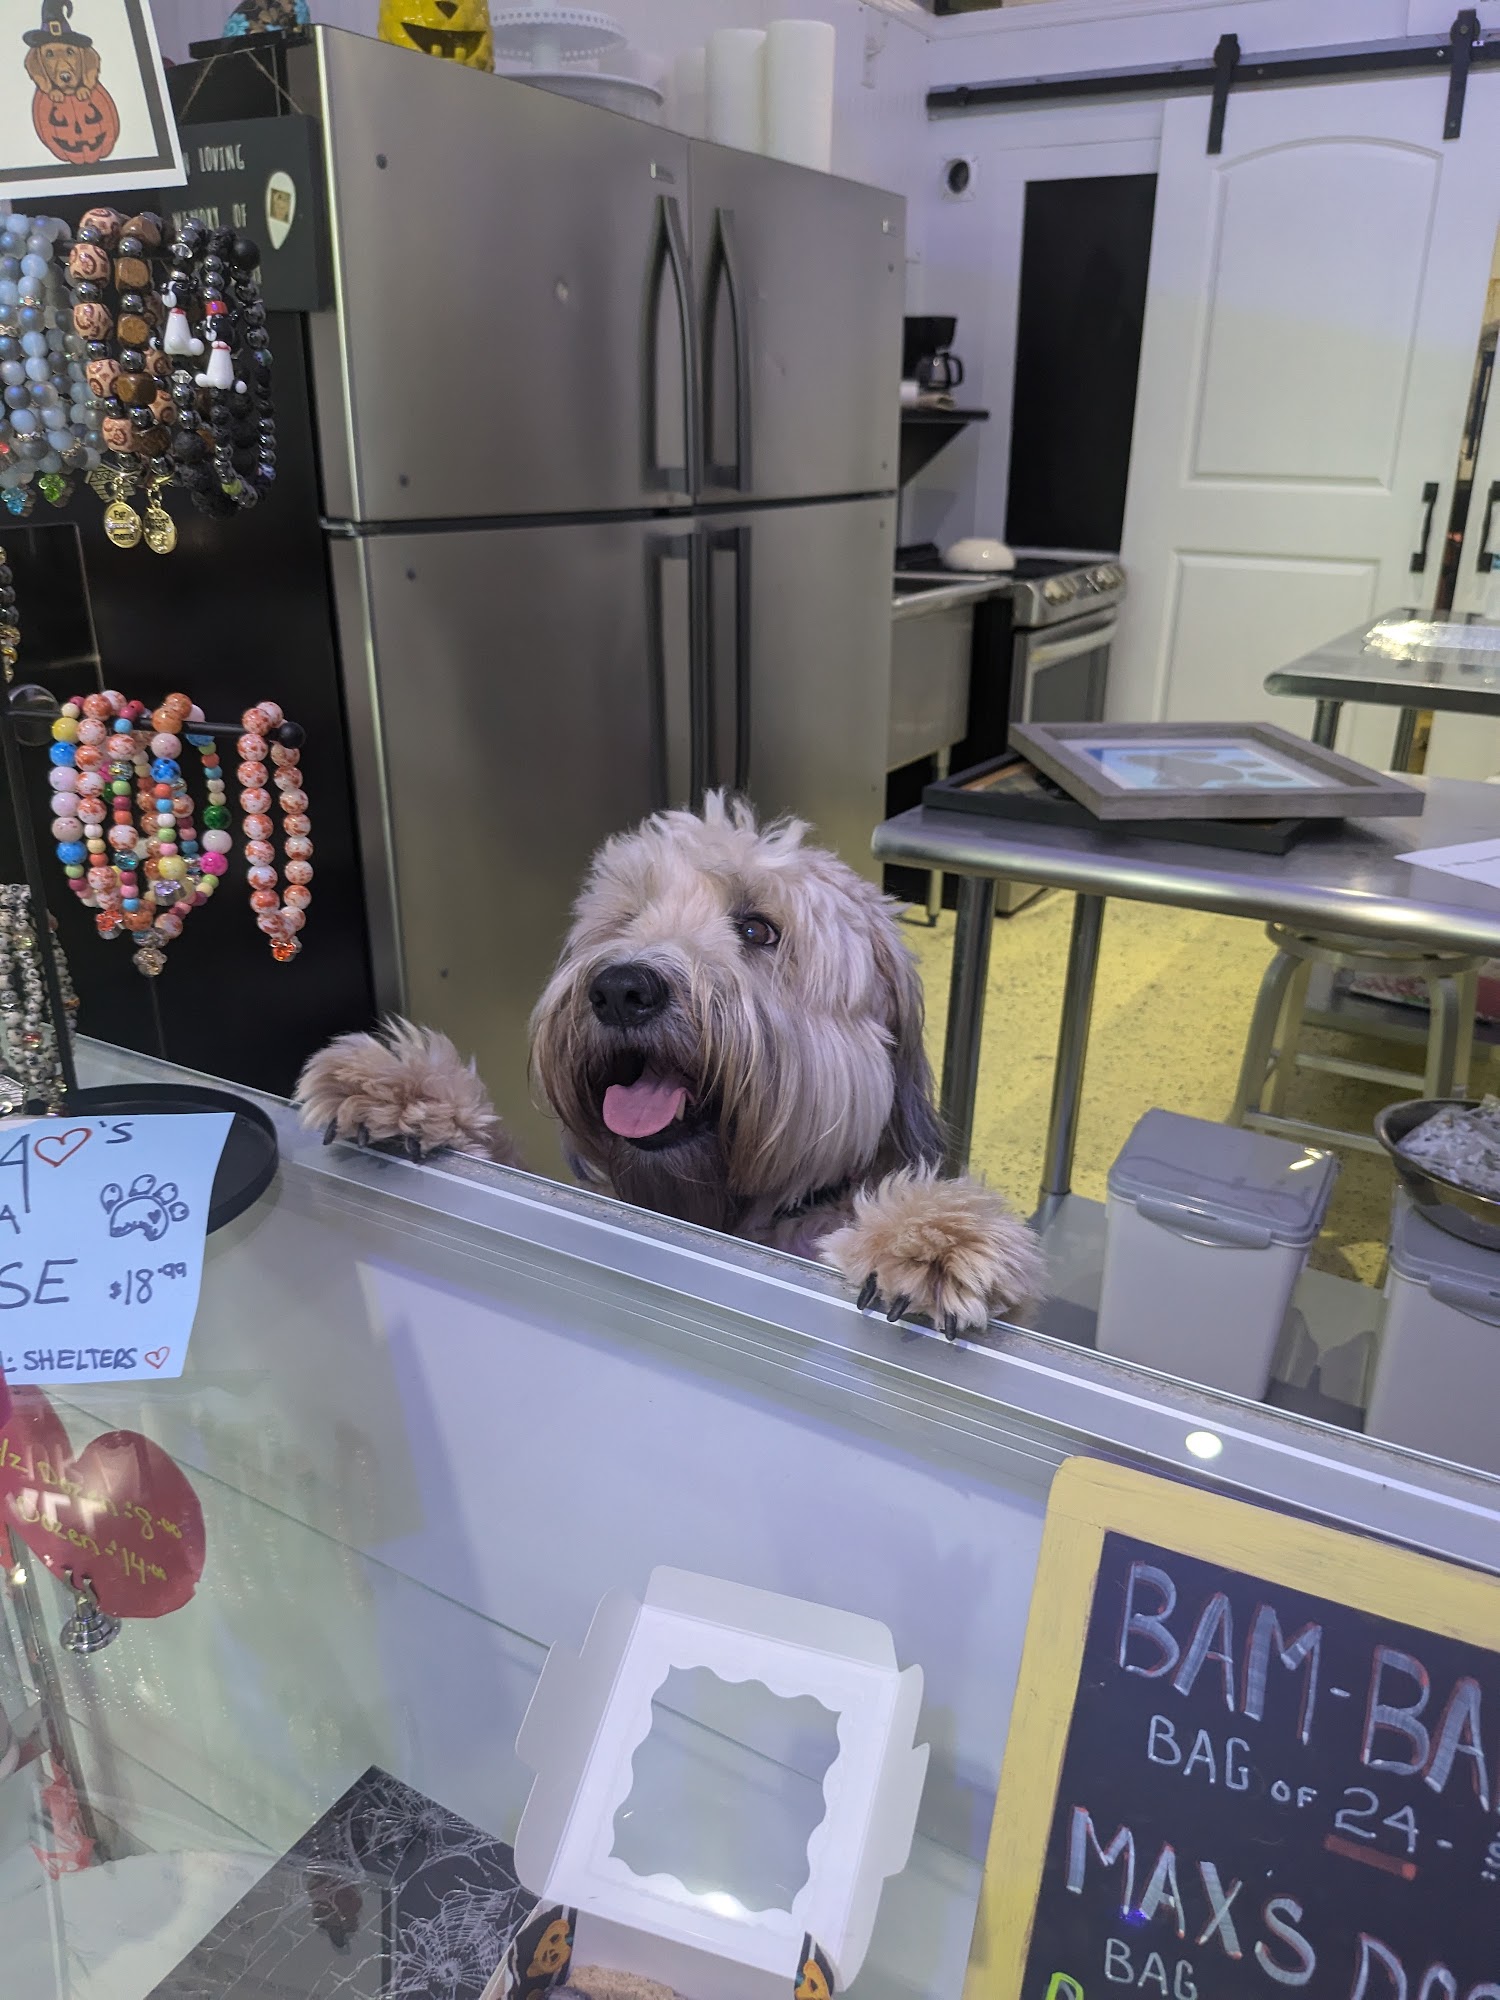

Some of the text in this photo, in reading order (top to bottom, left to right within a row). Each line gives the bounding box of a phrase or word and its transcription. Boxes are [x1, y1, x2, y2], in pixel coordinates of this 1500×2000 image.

[198, 144, 246, 172] LOVING
[232, 203, 247, 228] OF
[24, 1346, 138, 1371] SHELTERS
[1147, 1714, 1250, 1791] BAG
[1271, 1779, 1317, 1809] OF
[1334, 1787, 1420, 1854] 24
[1066, 1805, 1316, 1987] MAXS
[1104, 1937, 1198, 2000] BAG
